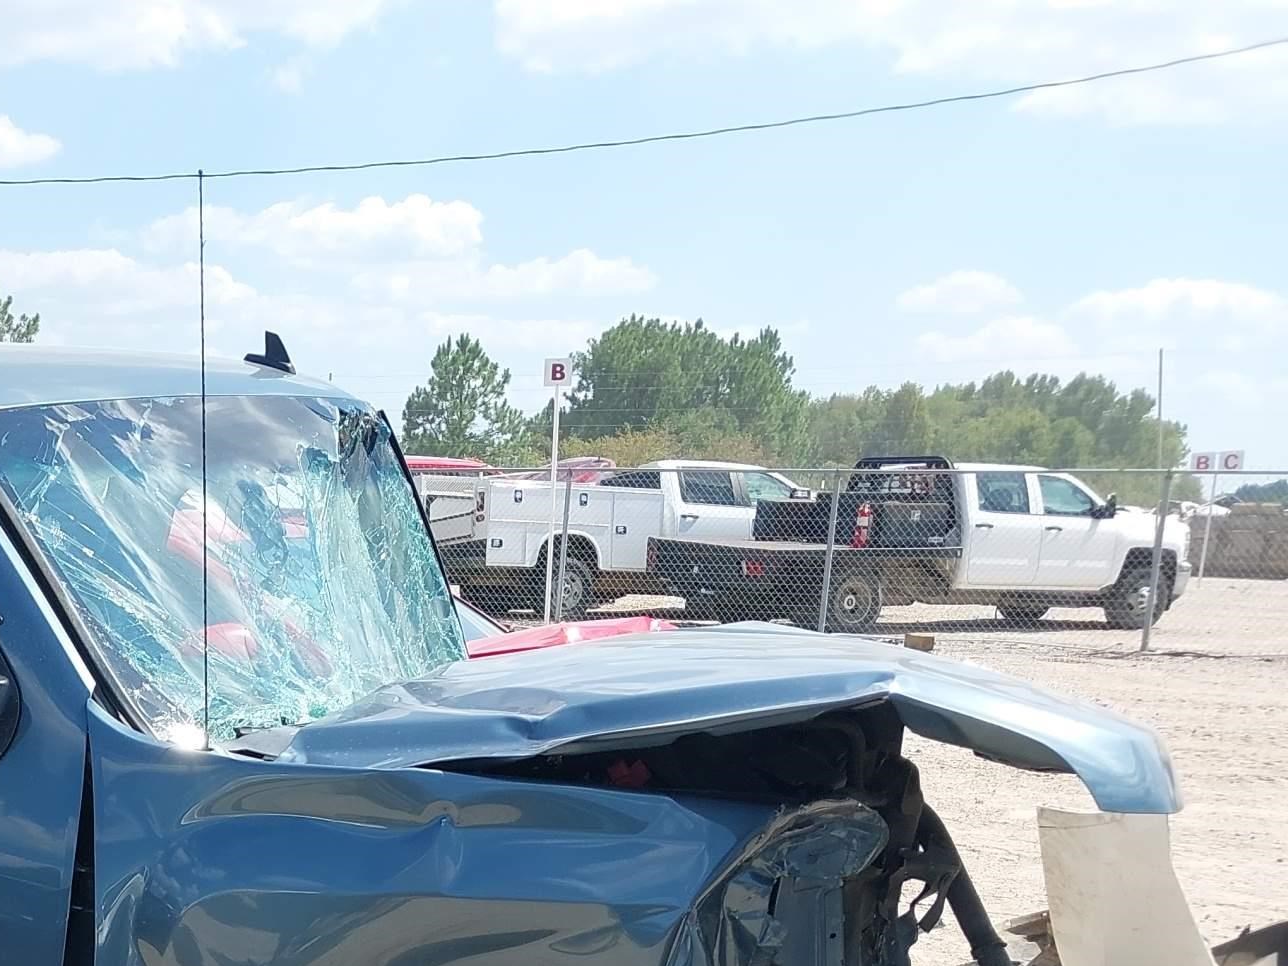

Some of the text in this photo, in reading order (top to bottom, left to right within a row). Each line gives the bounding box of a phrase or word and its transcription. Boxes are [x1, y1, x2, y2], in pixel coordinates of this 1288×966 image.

[551, 363, 566, 381] B
[1196, 455, 1210, 470] B
[1223, 454, 1239, 470] C
